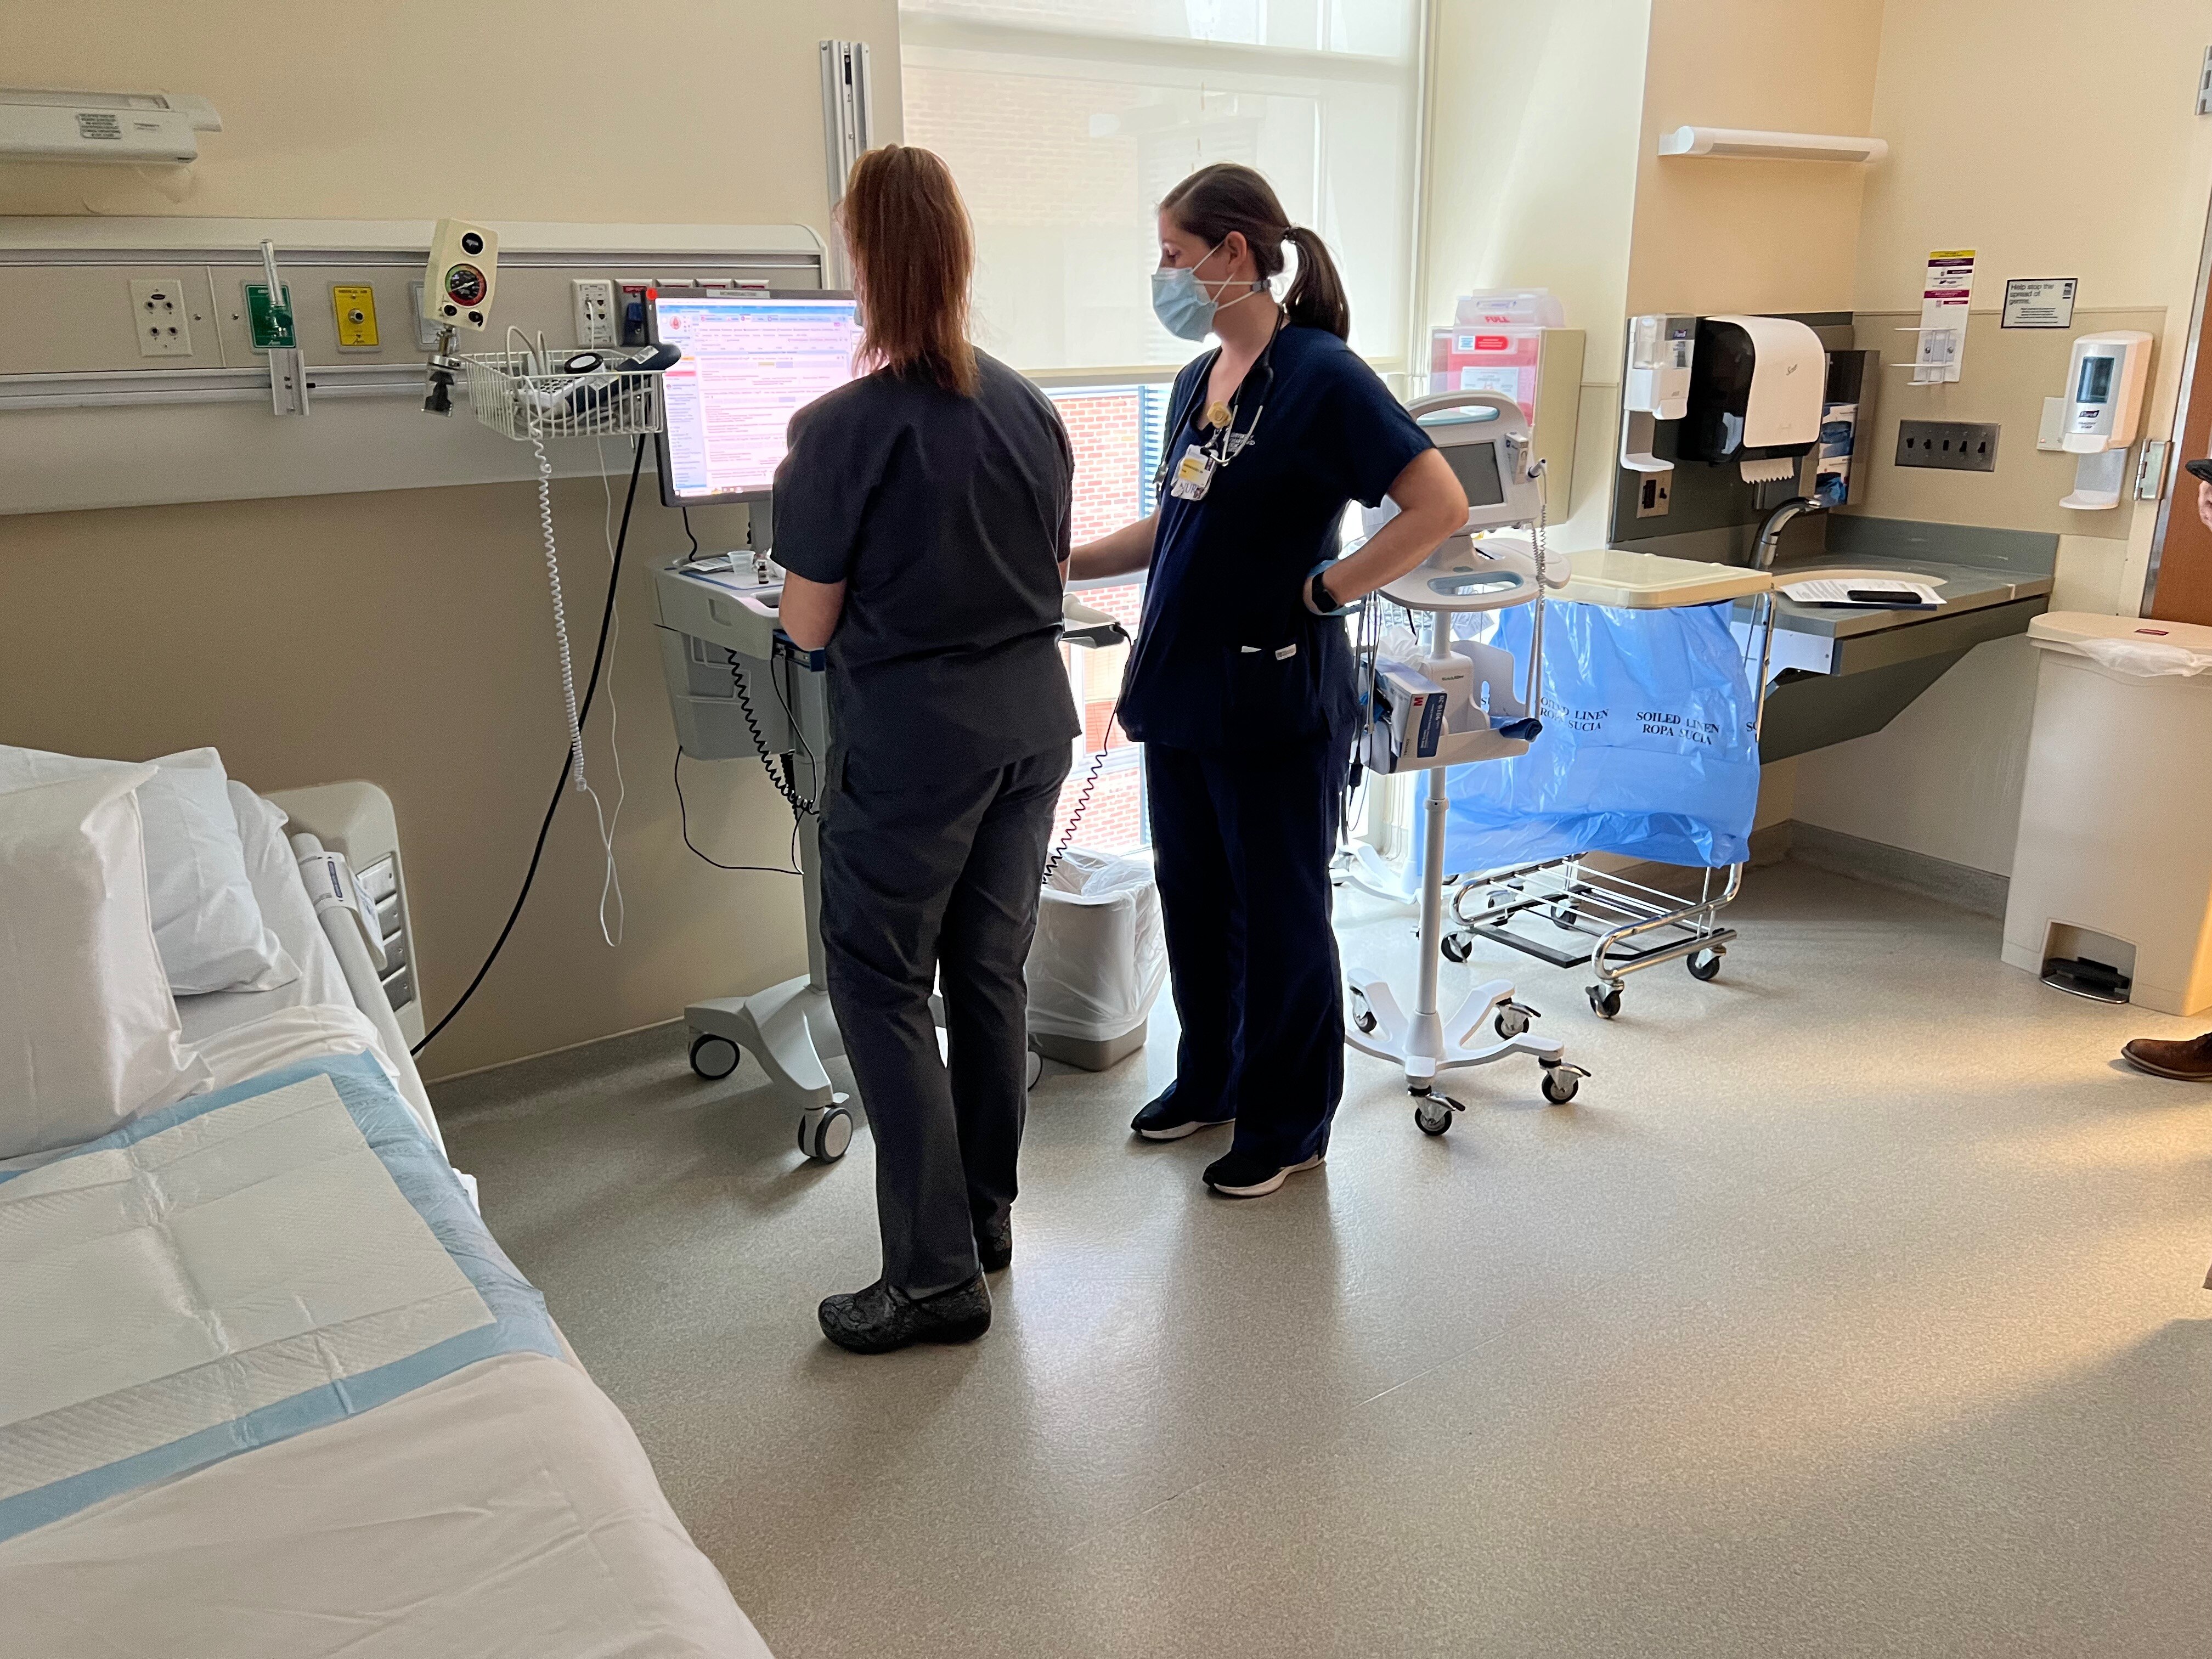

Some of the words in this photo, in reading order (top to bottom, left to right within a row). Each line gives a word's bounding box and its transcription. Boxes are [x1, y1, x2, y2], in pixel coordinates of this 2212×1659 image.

[1575, 708, 1609, 720] LINEN
[1568, 720, 1601, 731] SUCIA
[1636, 712, 1681, 724] SOILED
[1686, 718, 1720, 733] LINEN
[1643, 724, 1674, 736] ROPA
[1679, 729, 1712, 745] SUCIA
